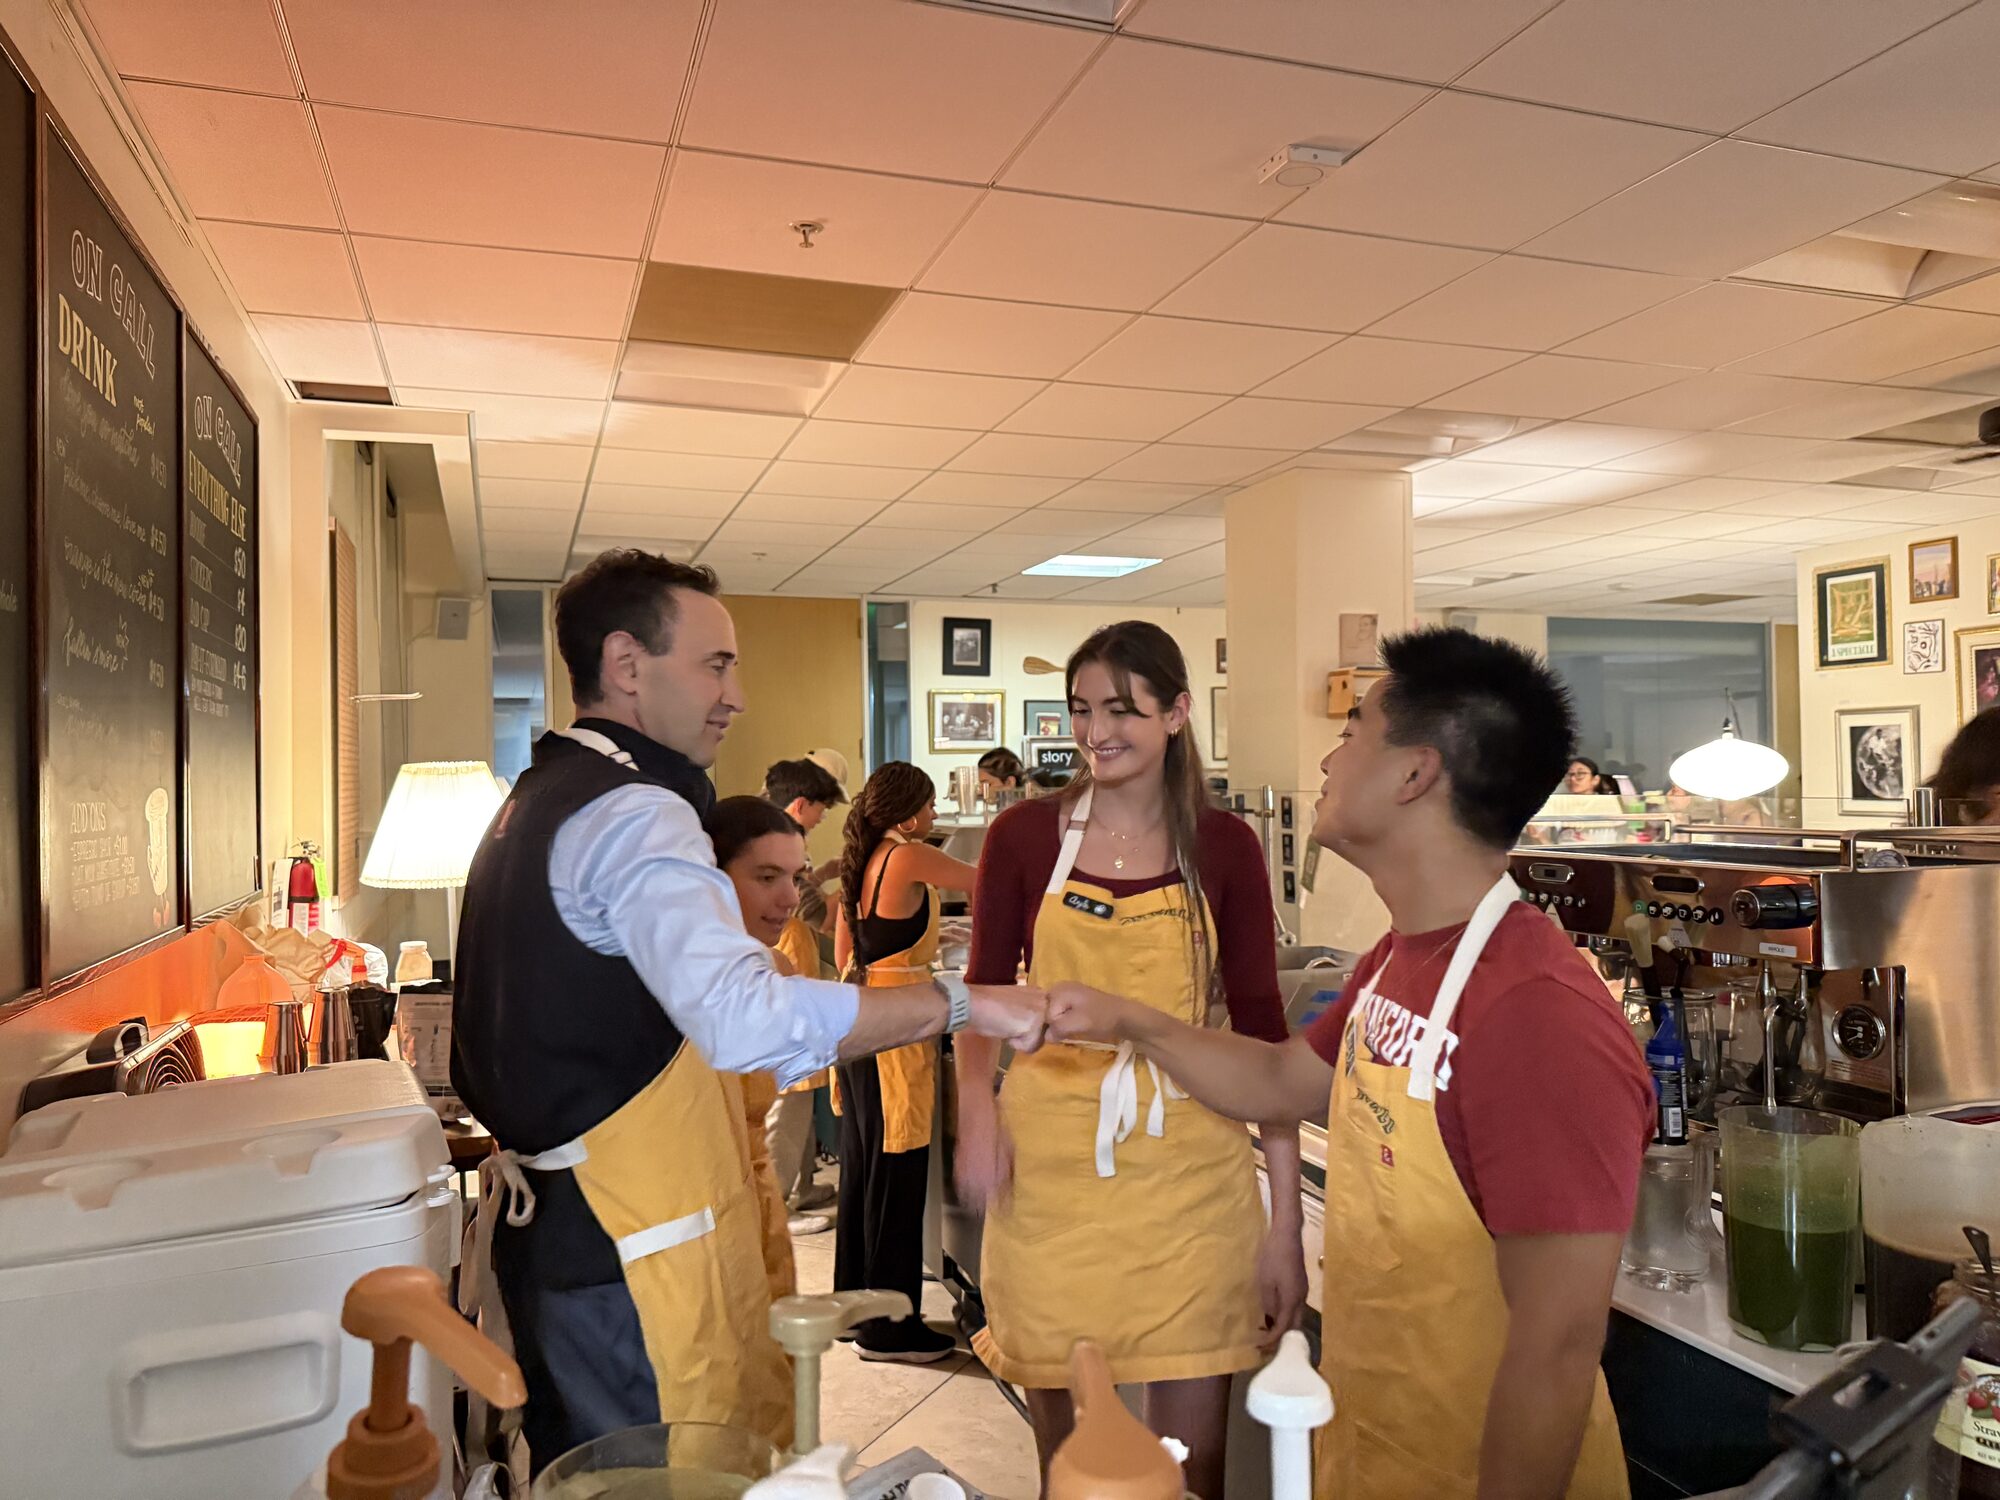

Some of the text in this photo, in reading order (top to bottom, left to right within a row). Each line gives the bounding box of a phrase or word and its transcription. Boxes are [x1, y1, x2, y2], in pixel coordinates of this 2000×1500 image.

[58, 292, 118, 408] DRINK
[71, 229, 155, 381] ON CALL
[194, 395, 242, 490] ON CALL
[188, 449, 247, 542] EVERYTHING ELSE
[1041, 750, 1073, 767] story
